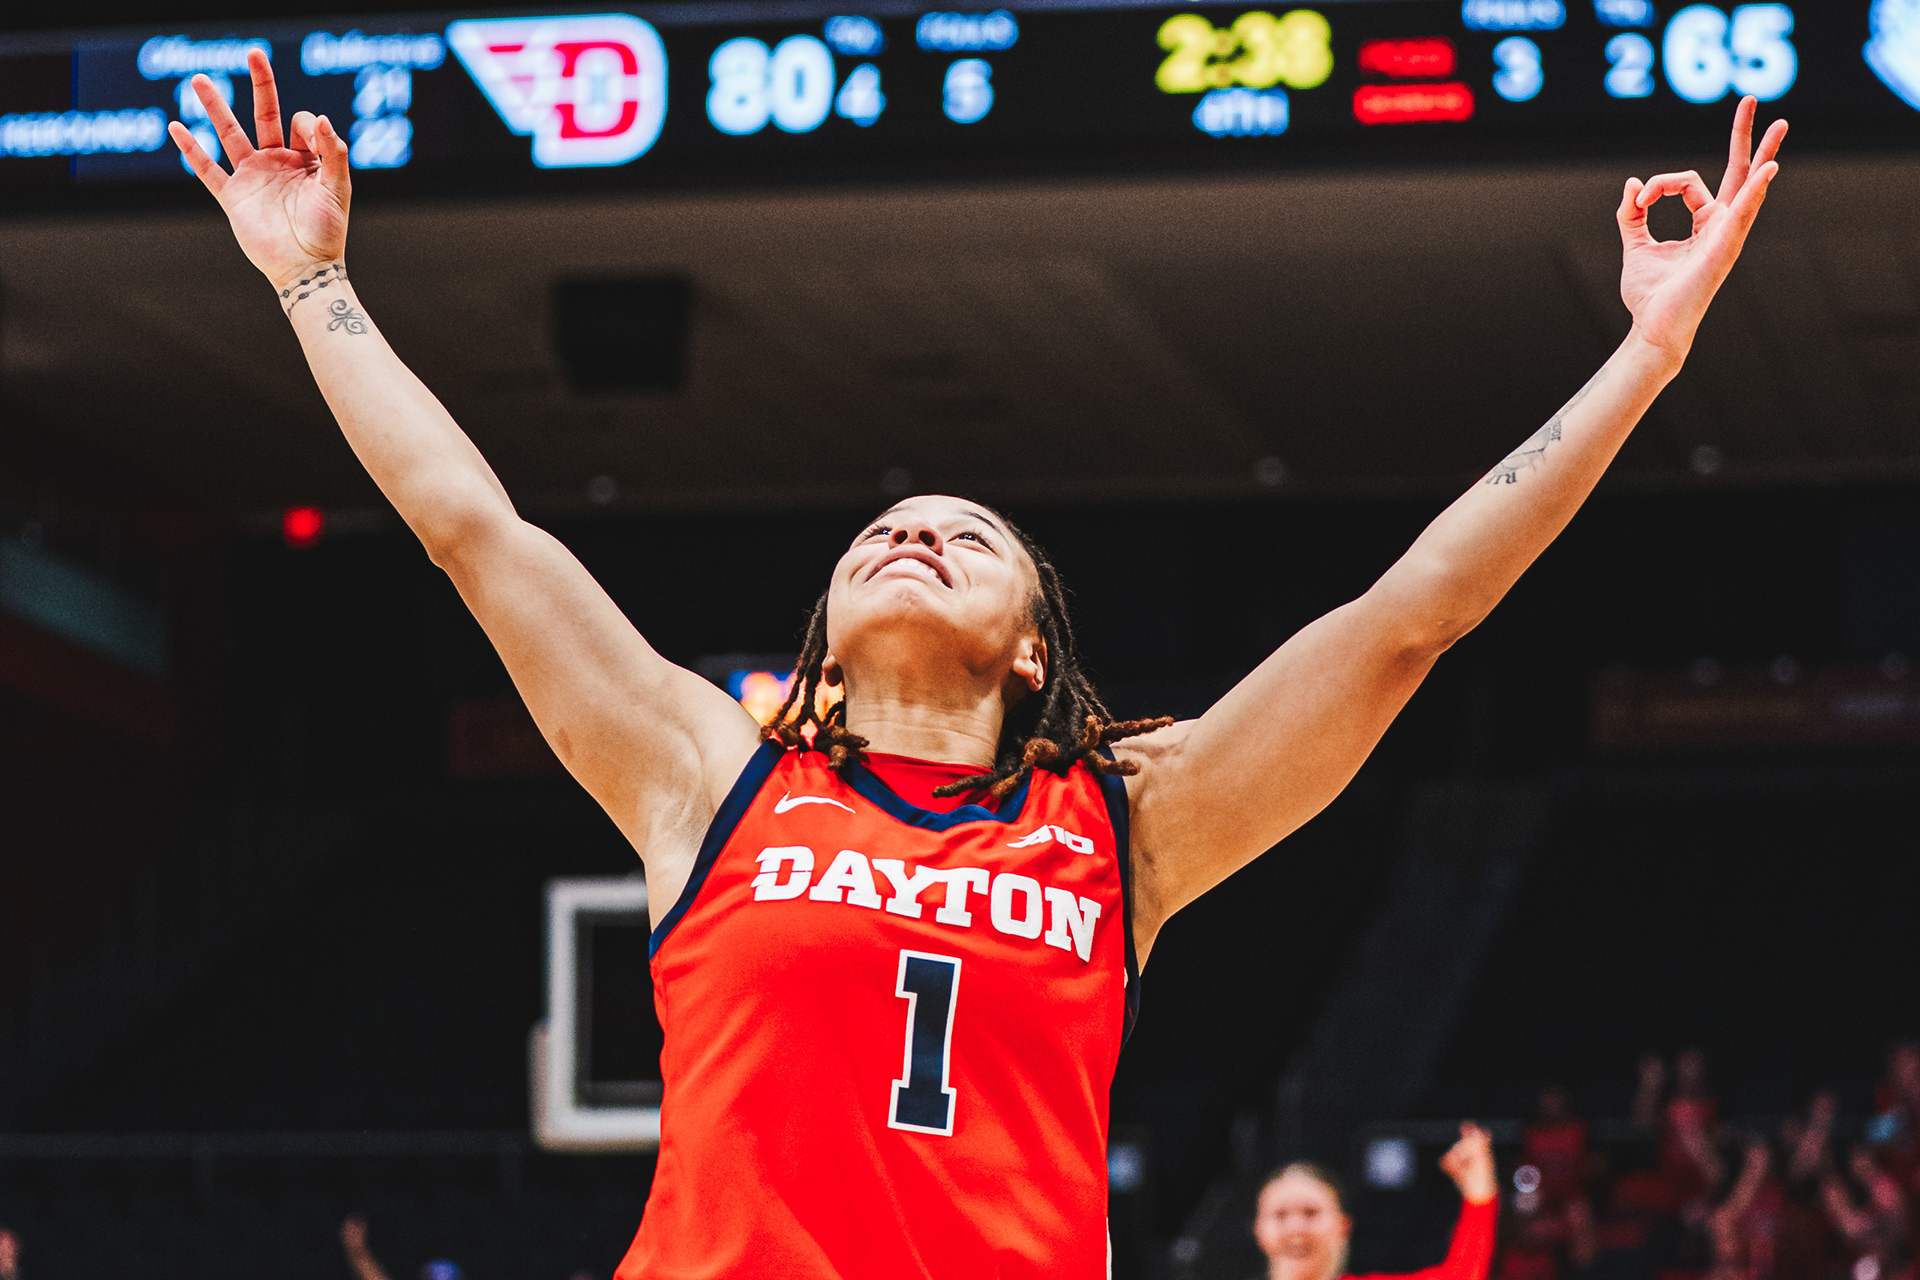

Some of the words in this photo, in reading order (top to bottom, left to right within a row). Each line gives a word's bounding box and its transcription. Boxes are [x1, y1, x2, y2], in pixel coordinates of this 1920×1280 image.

[706, 35, 834, 134] 80
[836, 63, 886, 125] 4
[1155, 10, 1333, 93] 2:38
[1493, 37, 1543, 101] 3
[1604, 33, 1654, 97] 2
[1663, 4, 1797, 103] 65
[750, 846, 1101, 962] DAYTON
[887, 949, 962, 1137] 1
